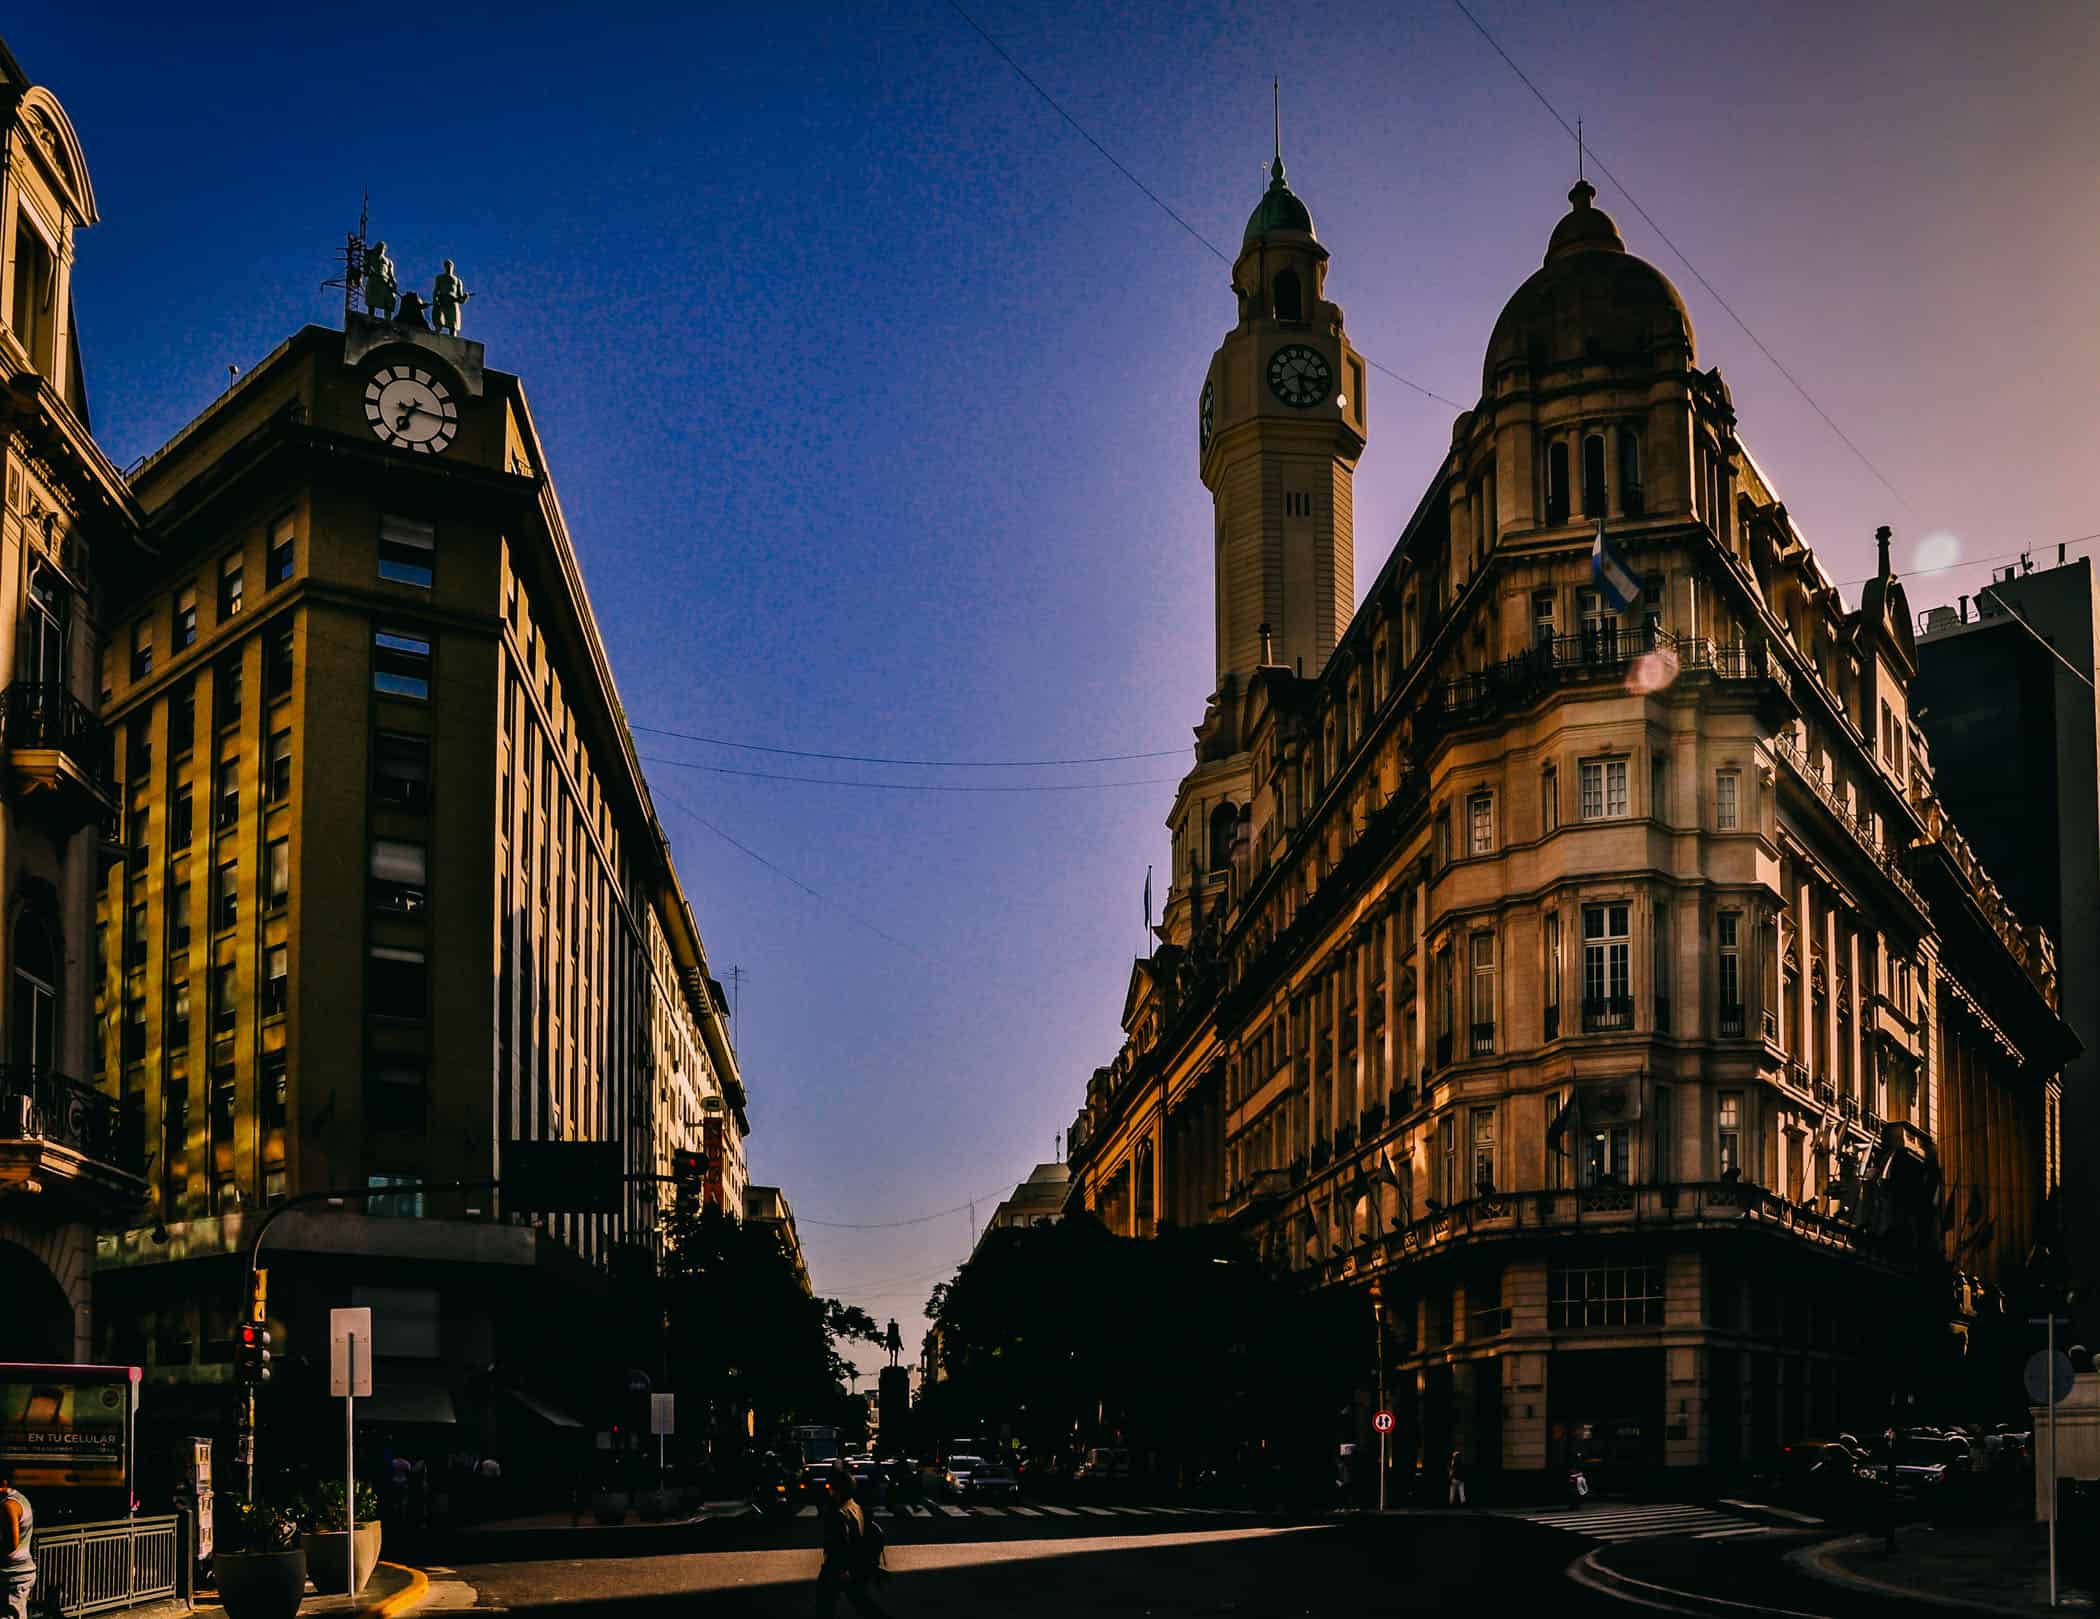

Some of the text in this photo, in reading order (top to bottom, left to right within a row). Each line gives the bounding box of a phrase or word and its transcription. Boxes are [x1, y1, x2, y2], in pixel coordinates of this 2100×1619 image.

[28, 1433, 117, 1443] EN TU CELULAR
